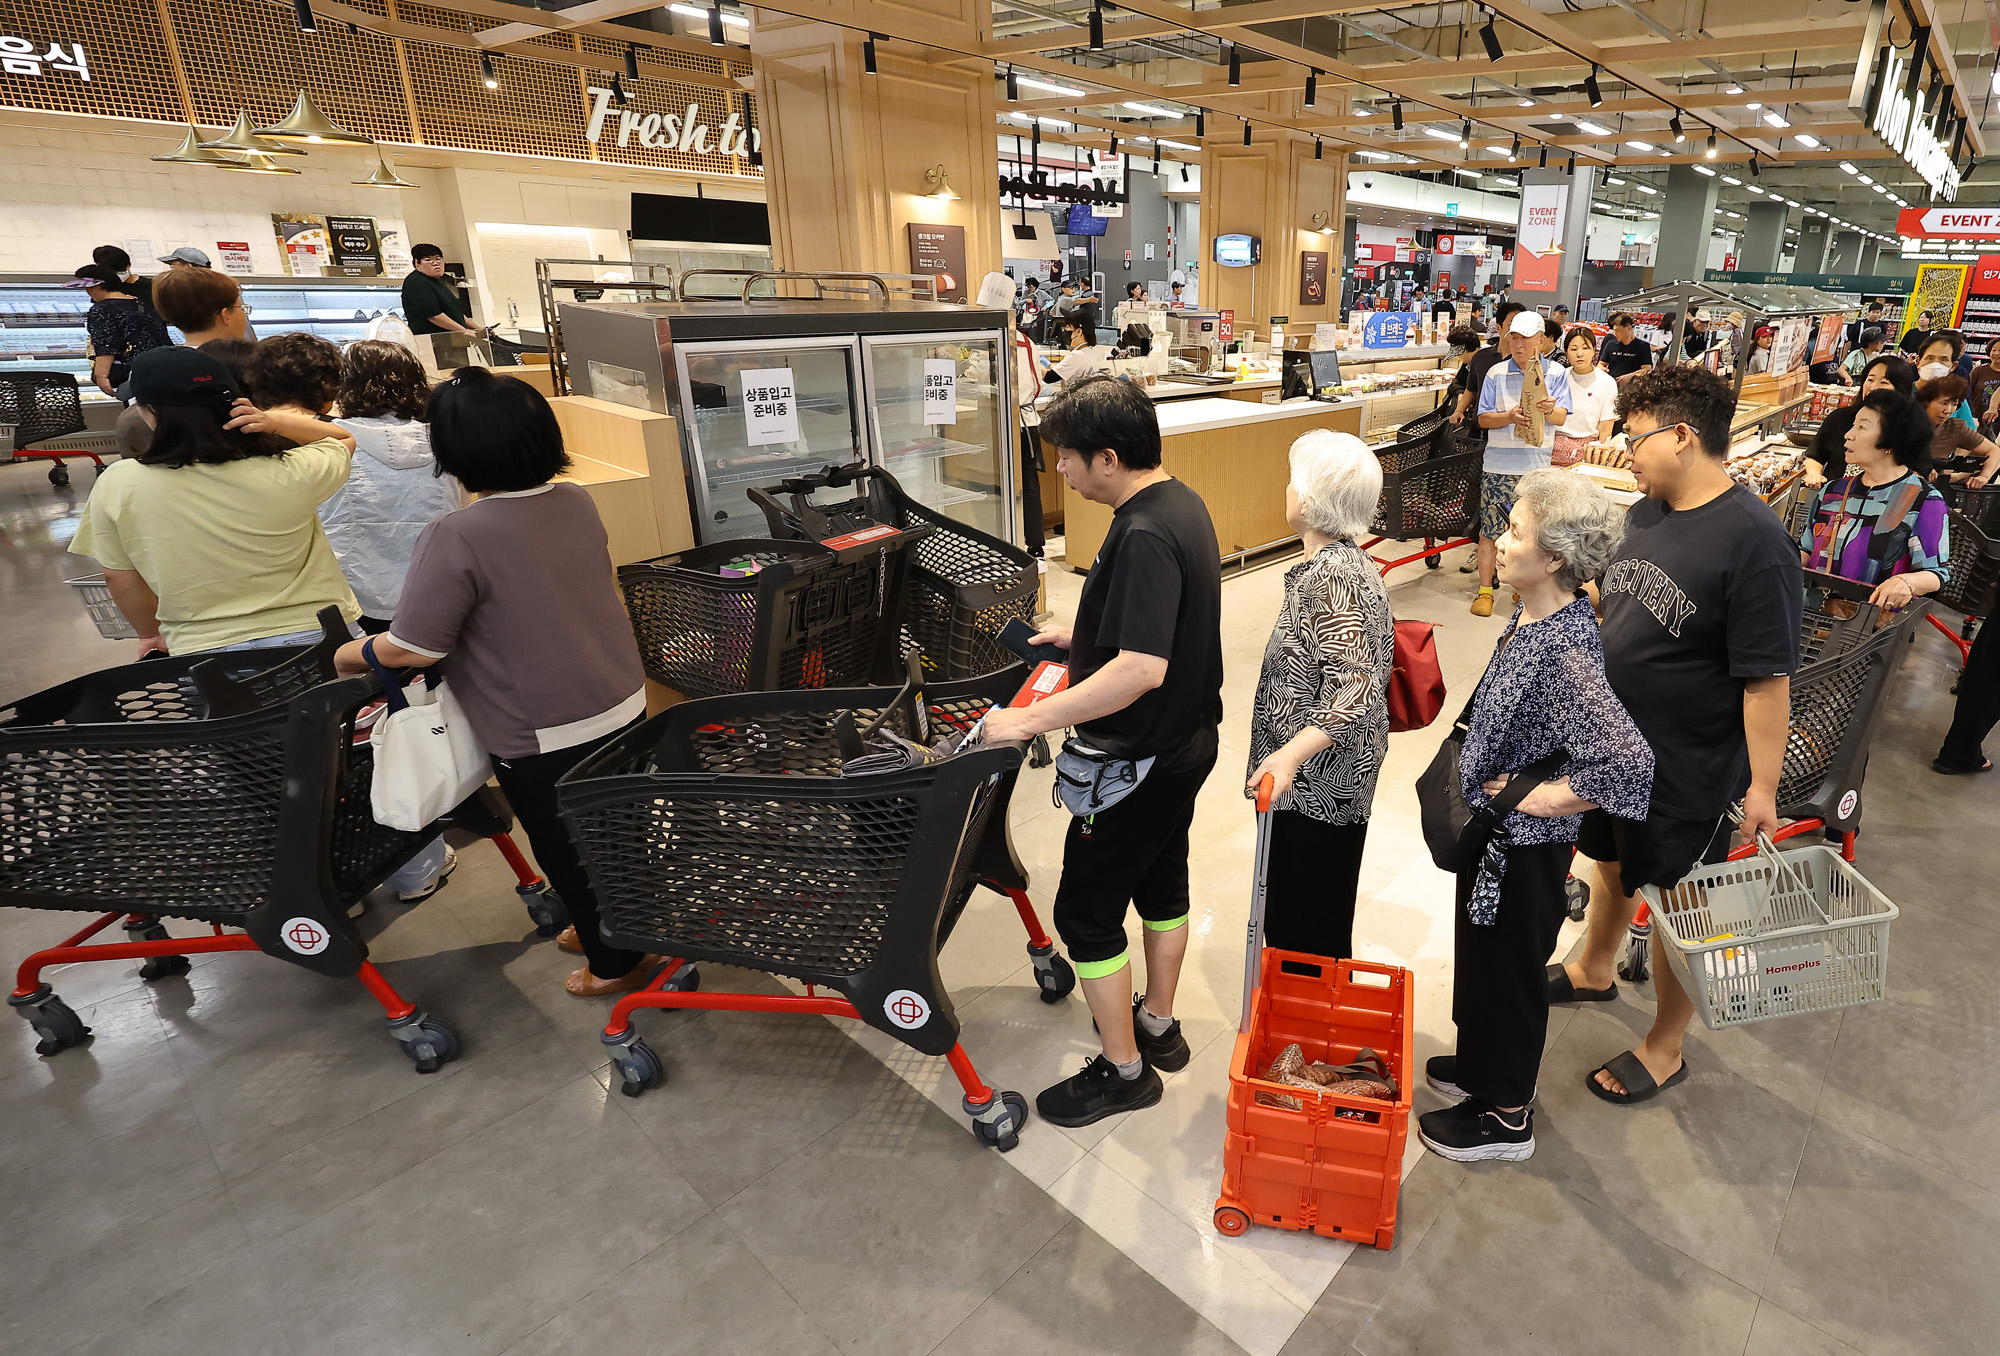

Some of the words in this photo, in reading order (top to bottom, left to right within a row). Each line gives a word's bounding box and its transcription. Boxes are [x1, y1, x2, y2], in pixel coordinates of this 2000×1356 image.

[0, 36, 91, 82] 음식
[586, 86, 716, 155] Fresh
[1529, 208, 1557, 216] EVENT
[1528, 217, 1556, 225] ZONE
[1941, 215, 1993, 226] EVENT
[745, 386, 792, 402] 상품입고
[753, 403, 787, 417] 준비중
[1600, 558, 1697, 638] DISCOVERY
[1765, 958, 1821, 975] Homeplus
